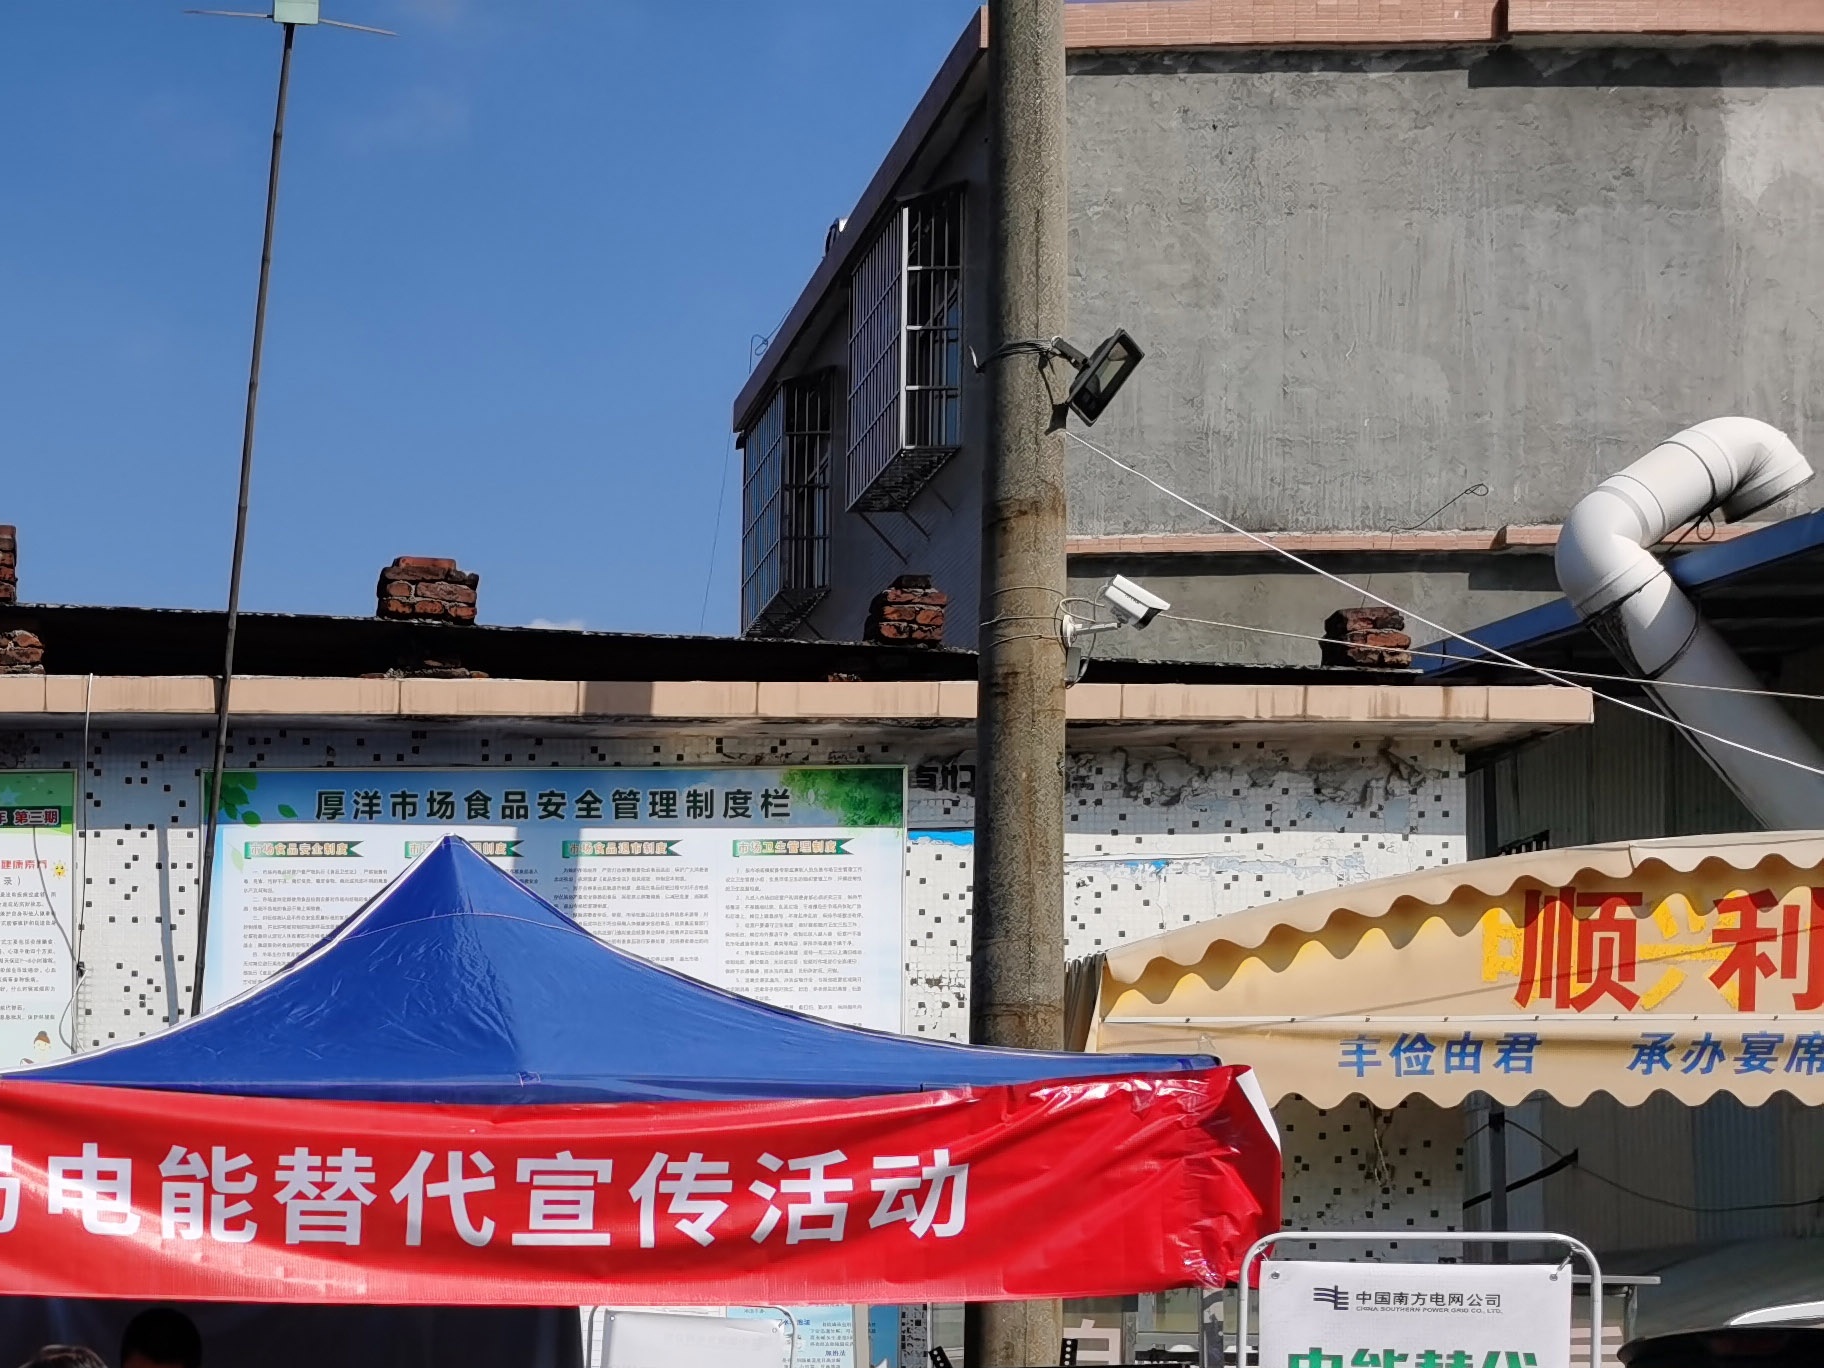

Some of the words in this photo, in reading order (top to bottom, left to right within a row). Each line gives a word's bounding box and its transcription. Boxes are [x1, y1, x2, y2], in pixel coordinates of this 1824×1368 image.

[314, 788, 792, 822] 厚洋市场食品安全管理制度栏
[13, 809, 59, 825] 第三期
[251, 842, 348, 856] 市场食品安全制度
[738, 840, 837, 854] 市场卫生管理制度
[1513, 886, 1824, 1013] 顺利
[1337, 1031, 1542, 1077] 丰俭由君
[1626, 1030, 1824, 1076] 承办宴席
[1355, 1290, 1502, 1308] 中国南方电网公司
